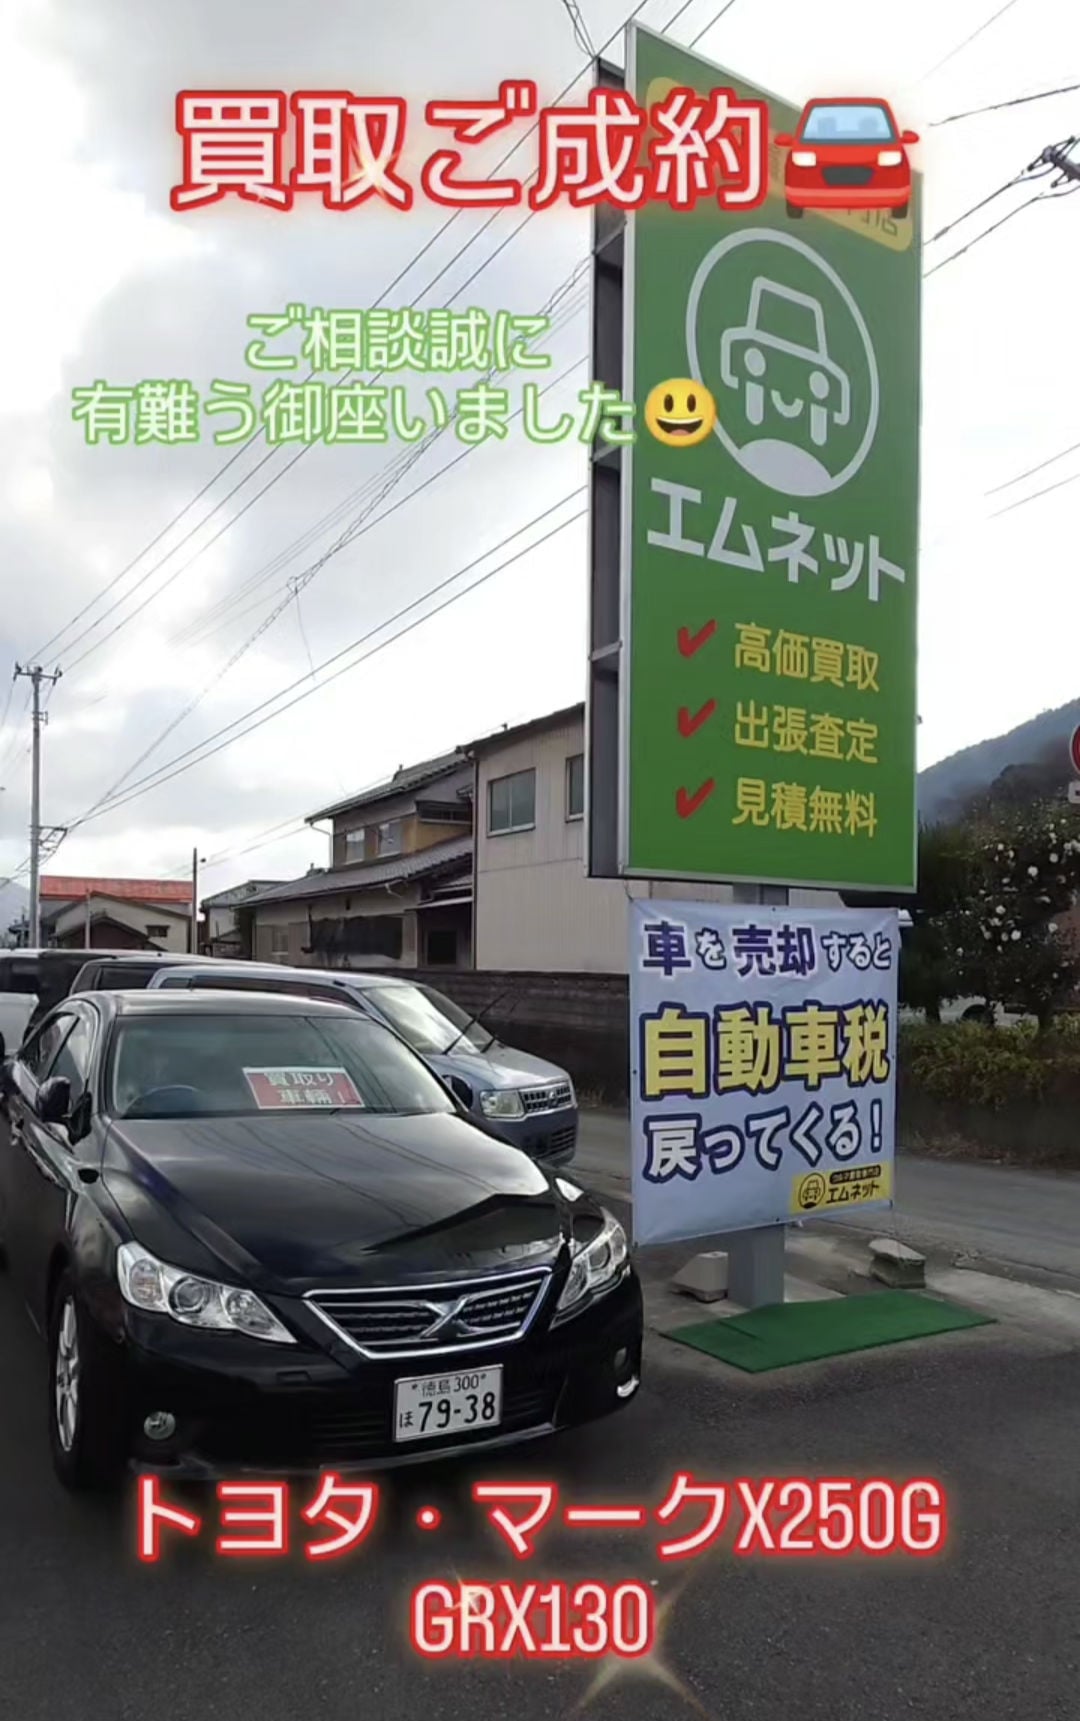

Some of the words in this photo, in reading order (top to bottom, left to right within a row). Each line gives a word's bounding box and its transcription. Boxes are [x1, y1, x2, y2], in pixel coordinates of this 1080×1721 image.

[647, 477, 906, 602] エムネット
[734, 622, 880, 692] 高価買取
[734, 699, 879, 764] 出張査定
[732, 777, 878, 838] 見積無料
[642, 920, 893, 978] 車を売却すると
[639, 1000, 890, 1101] 自動車税
[642, 1098, 884, 1183] 戻ってくる!
[826, 1180, 879, 1204] エムネット
[418, 1391, 496, 1432] 79-38
[453, 1374, 480, 1392] 300
